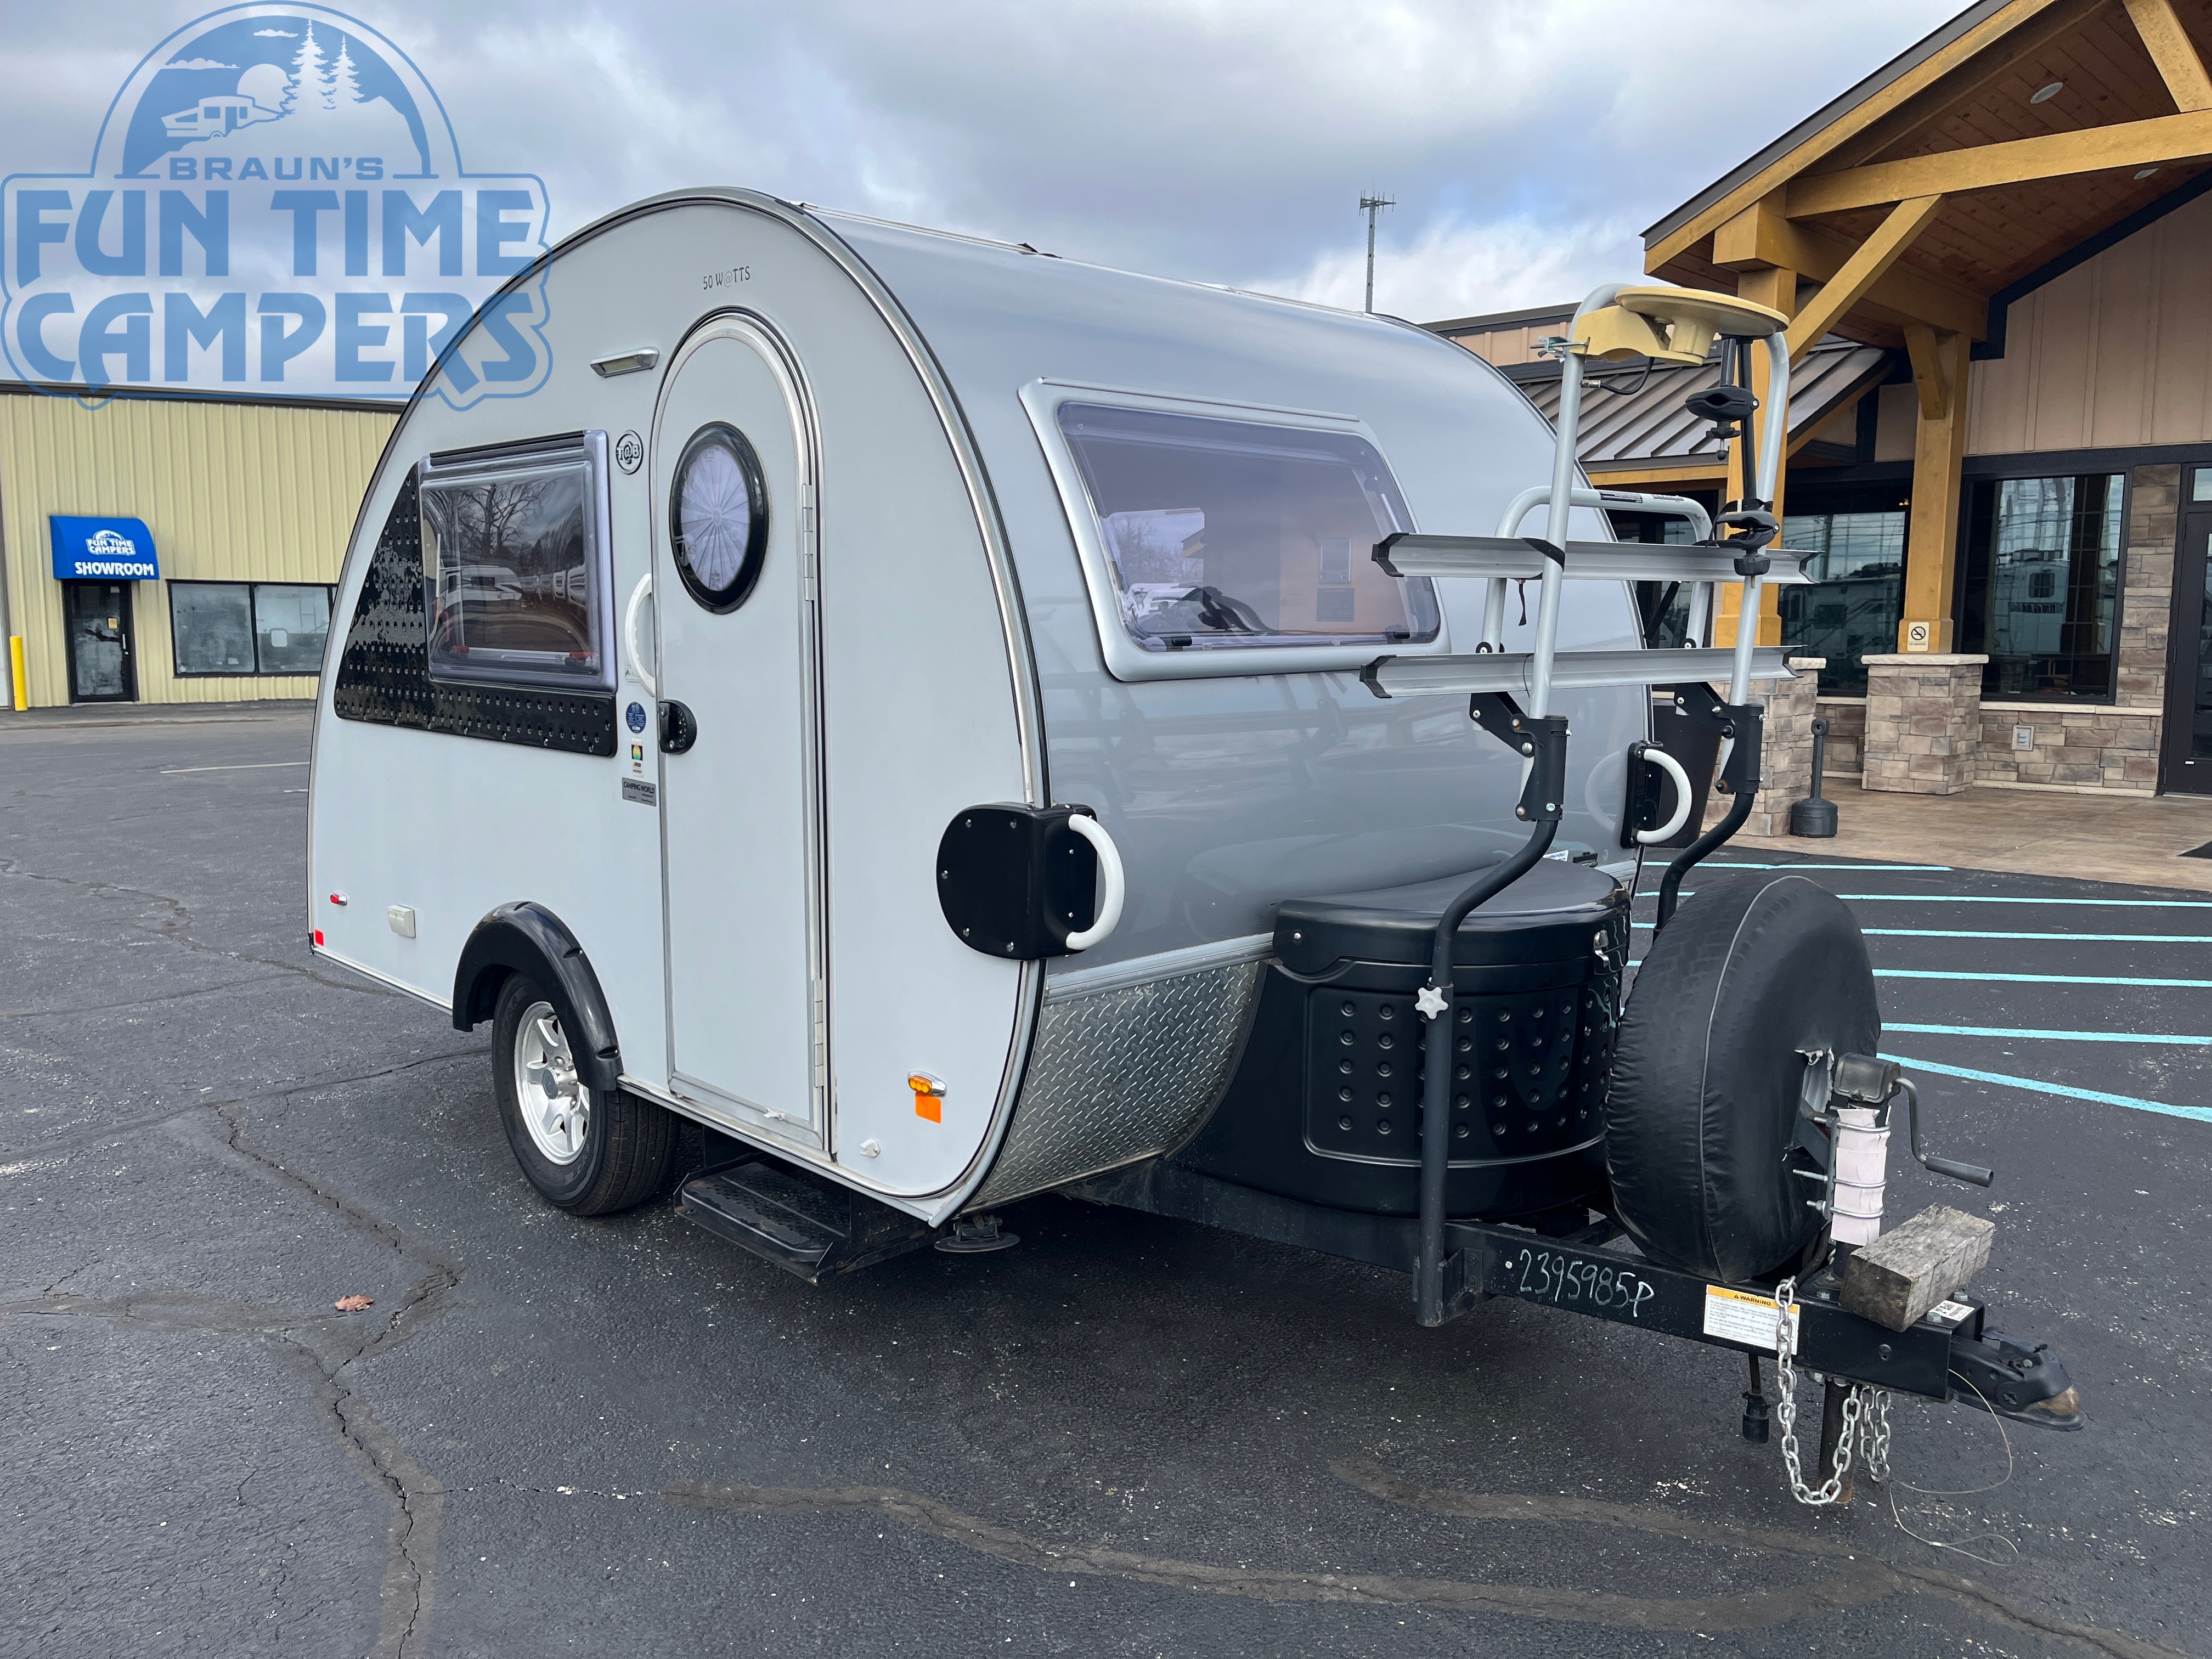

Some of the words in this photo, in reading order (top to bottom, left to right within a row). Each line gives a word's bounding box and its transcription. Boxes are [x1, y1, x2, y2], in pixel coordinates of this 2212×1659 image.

[703, 275, 713, 290] 50
[715, 266, 750, 287] W@TTS
[616, 441, 640, 465] T@B
[89, 546, 135, 554] CAMPERS
[75, 561, 154, 576] SHOWROOM
[623, 781, 641, 791] CAMPING
[641, 786, 655, 794] WORLD
[1520, 1249, 1655, 1317] 2395985P
[1740, 1295, 1771, 1306] WARNING
